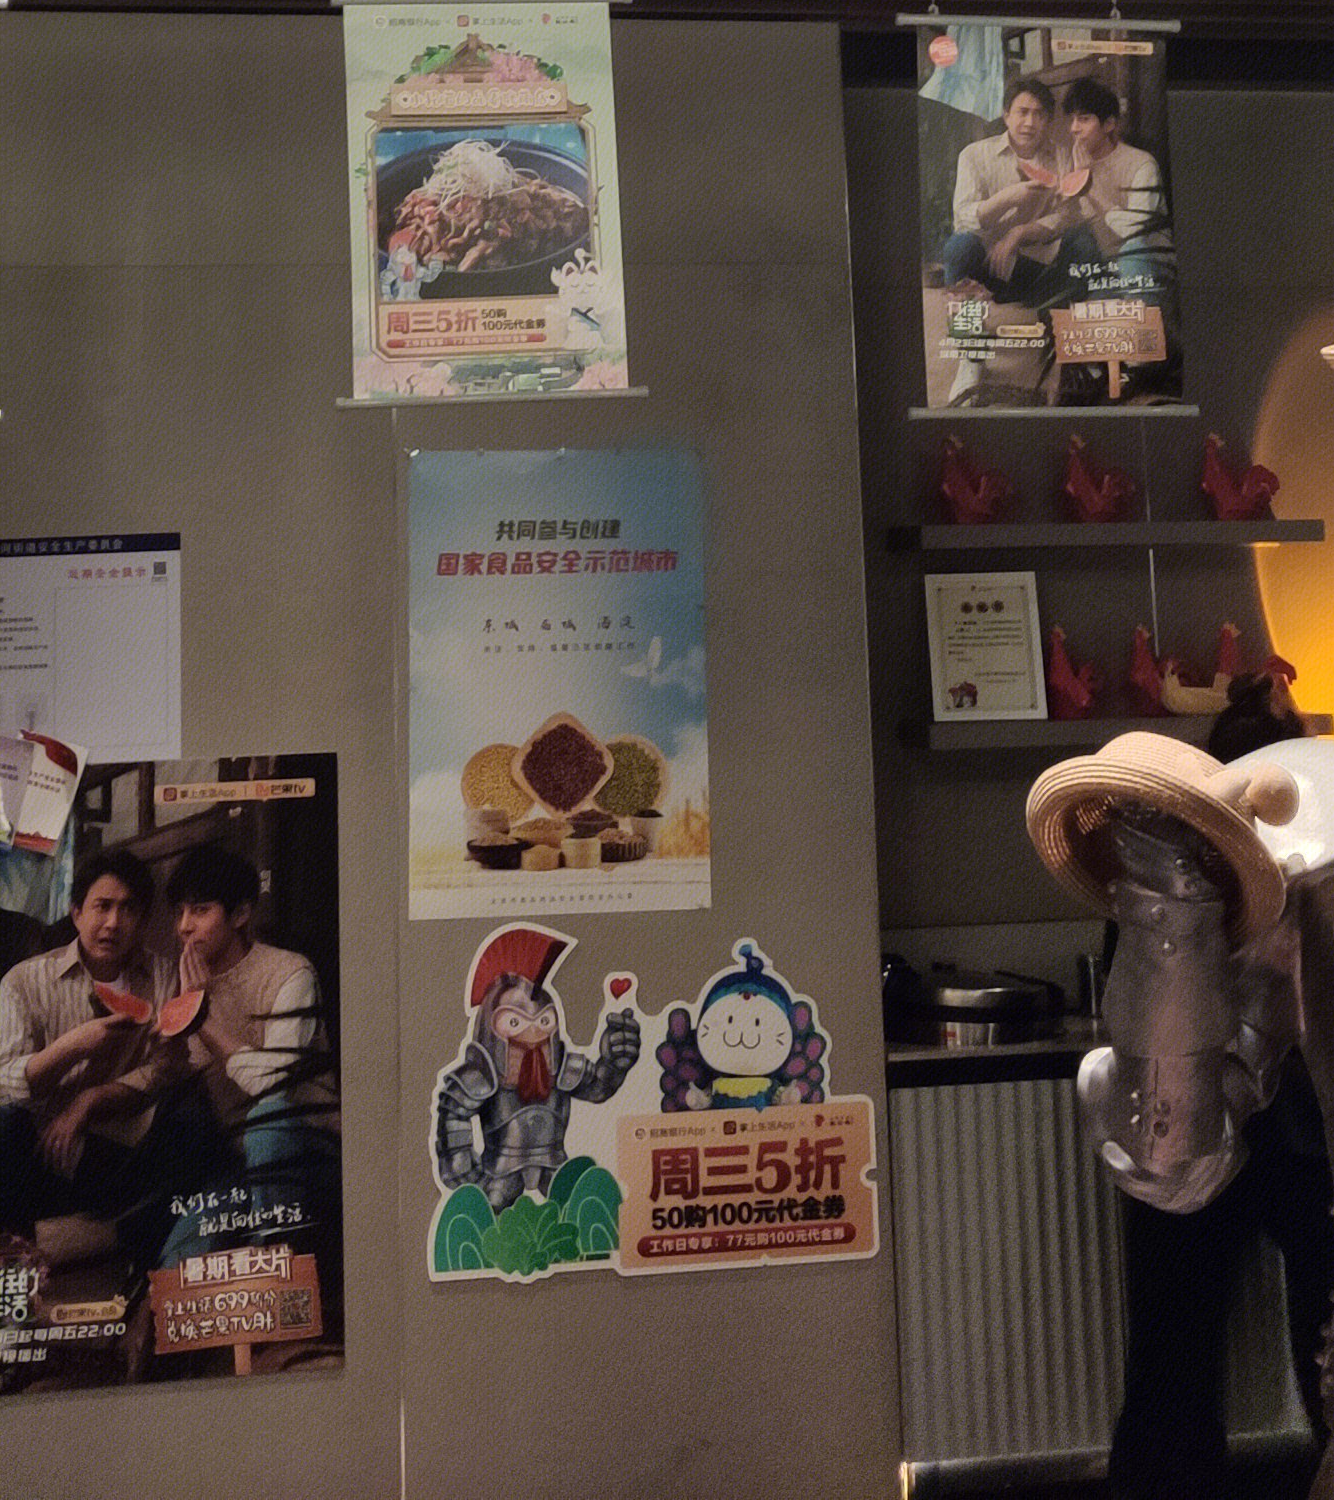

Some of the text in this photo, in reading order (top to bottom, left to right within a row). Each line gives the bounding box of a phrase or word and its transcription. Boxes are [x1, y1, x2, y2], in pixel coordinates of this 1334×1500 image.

[386, 308, 479, 336] 周三5折
[496, 519, 621, 542] 共同参与创建
[436, 550, 679, 576] 国家食品安全示范城市
[649, 1135, 847, 1202] 周三5折
[652, 1194, 846, 1231] 50购100元代金券
[183, 1248, 291, 1283] 暑期看大片
